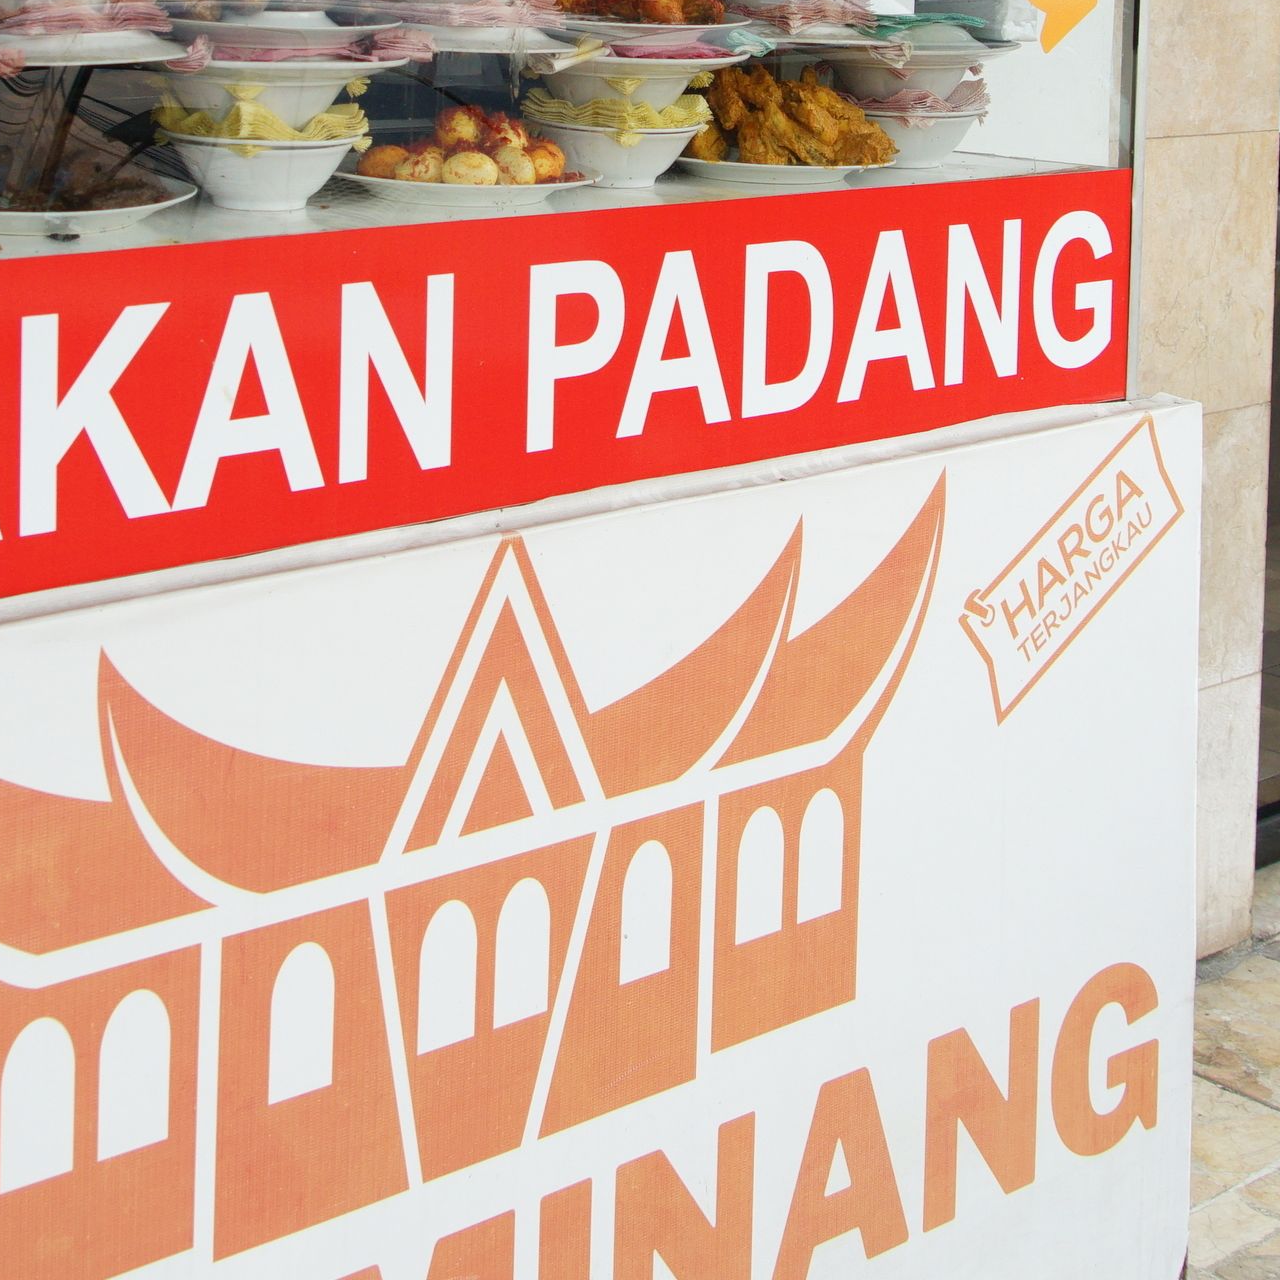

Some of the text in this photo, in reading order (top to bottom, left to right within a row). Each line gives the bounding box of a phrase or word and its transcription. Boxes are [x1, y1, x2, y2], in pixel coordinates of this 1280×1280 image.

[527, 211, 1112, 452] PADANG
[1000, 470, 1144, 640] HARGA
[1017, 501, 1153, 662] TERJANGKAU
[322, 964, 1159, 1280] NANG
